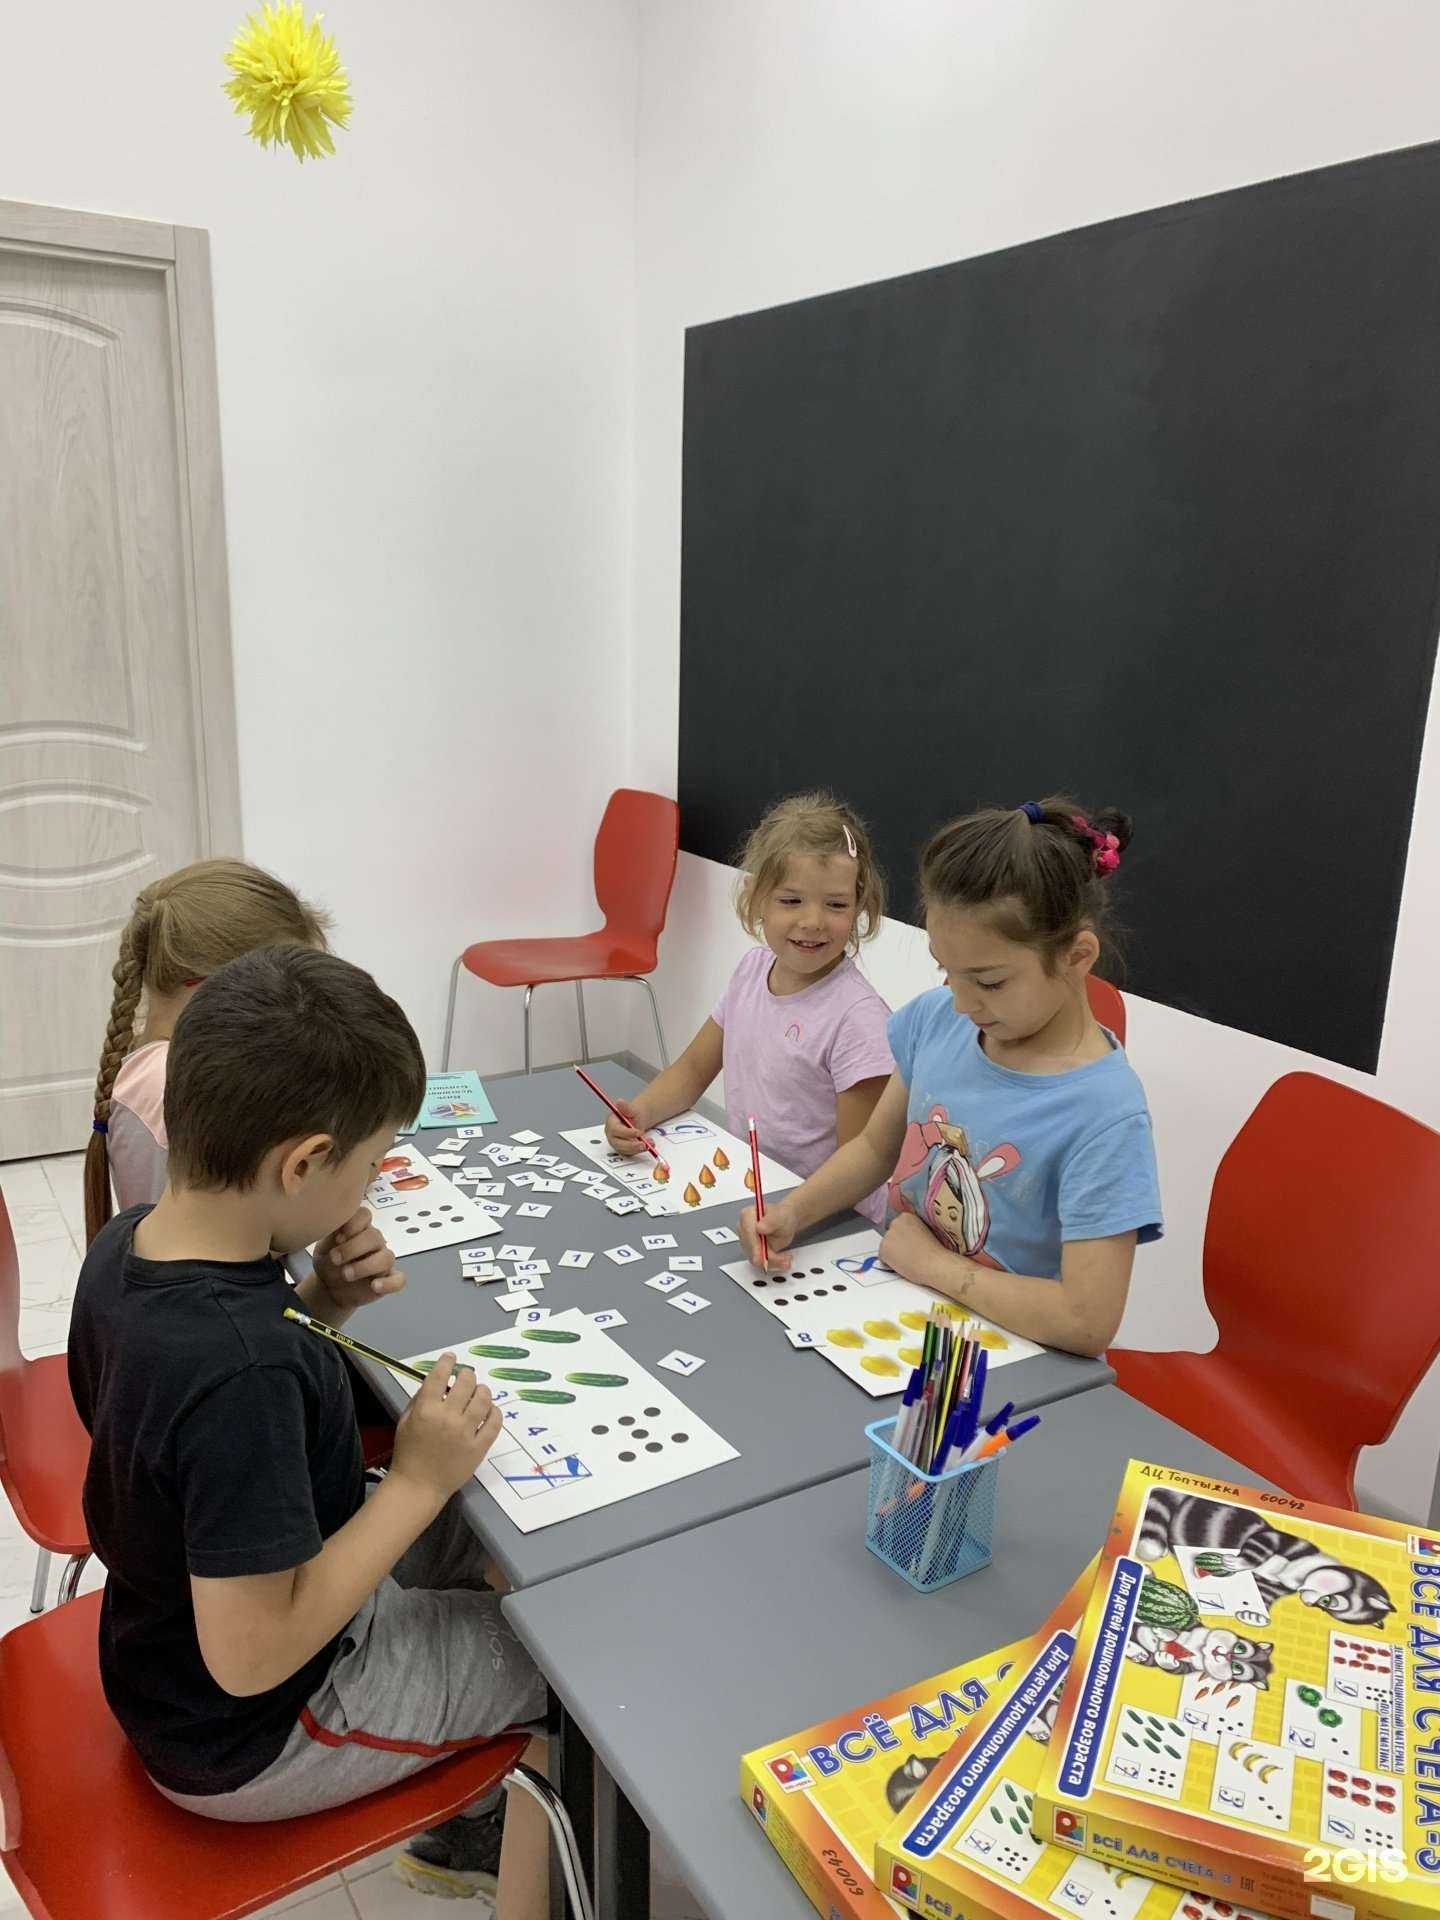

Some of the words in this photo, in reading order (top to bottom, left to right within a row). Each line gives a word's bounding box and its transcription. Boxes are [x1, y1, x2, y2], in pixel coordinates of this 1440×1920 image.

[1109, 1594, 1128, 1632] детей
[1119, 1571, 1136, 1595] Для
[1021, 1667, 1050, 1706] детей
[1045, 1645, 1069, 1671] Для
[1086, 1629, 1118, 1718] дошкольного
[808, 1713, 901, 1777] ВСЁ
[908, 1678, 991, 1740] ДЛЯ
[962, 1701, 1026, 1787] дошкольного
[1068, 1719, 1097, 1785] возраста
[915, 1786, 967, 1846] возраста
